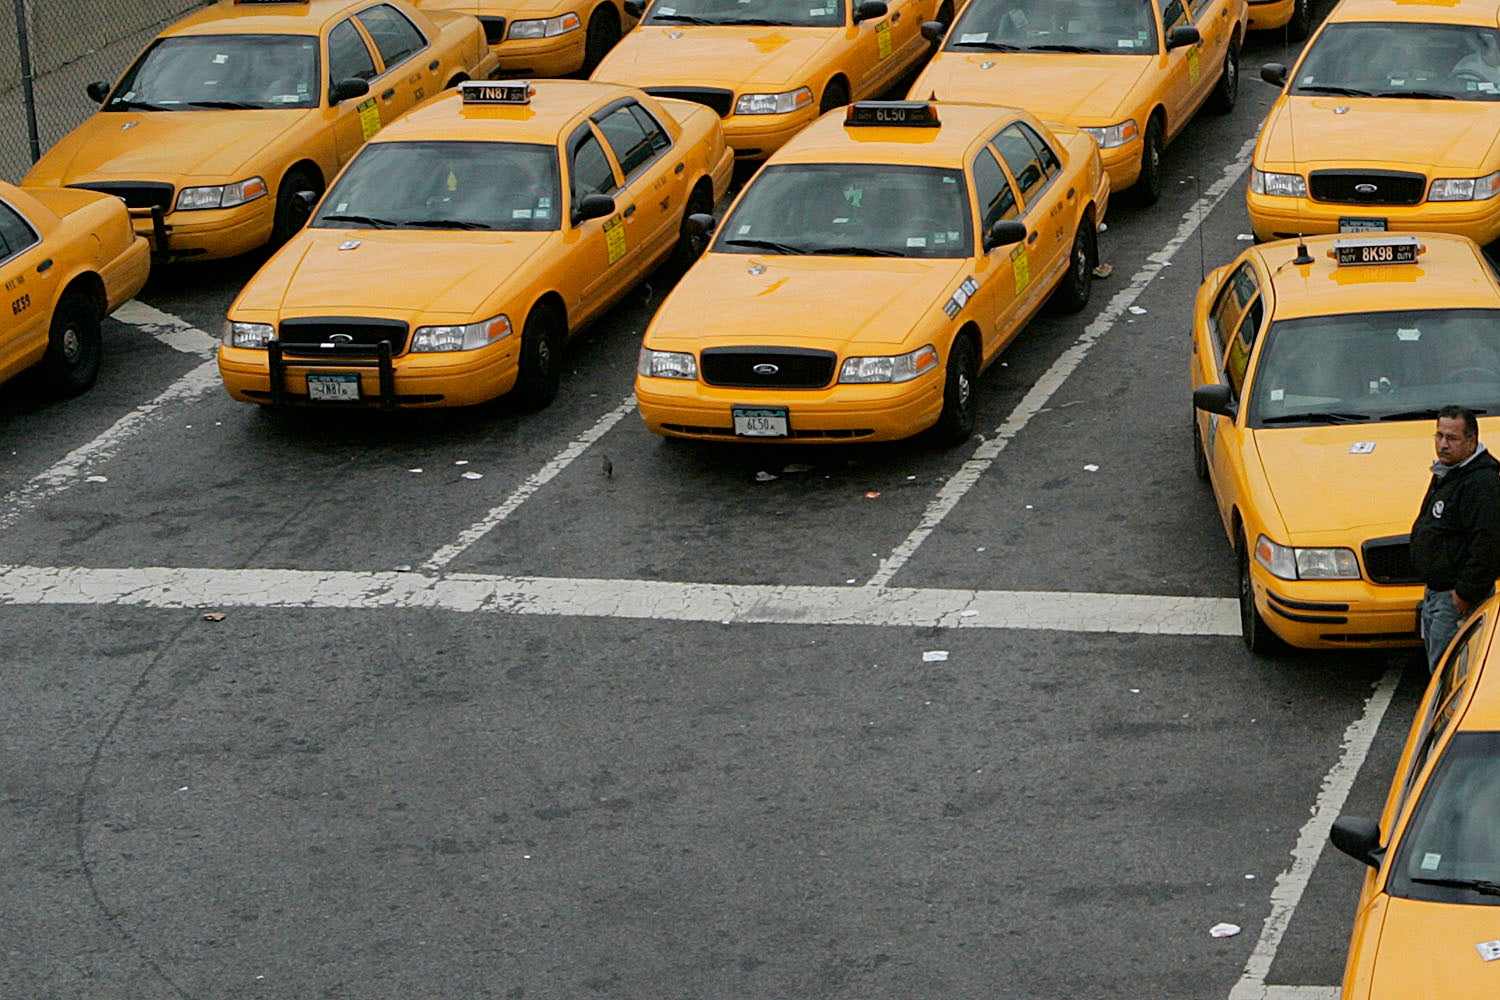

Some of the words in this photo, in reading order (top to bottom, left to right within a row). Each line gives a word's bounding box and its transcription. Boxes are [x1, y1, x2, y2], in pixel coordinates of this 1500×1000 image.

[479, 87, 508, 99] 7N87
[877, 109, 906, 120] 6L50
[1362, 246, 1393, 261] 8K98
[1397, 252, 1412, 260] DUTY
